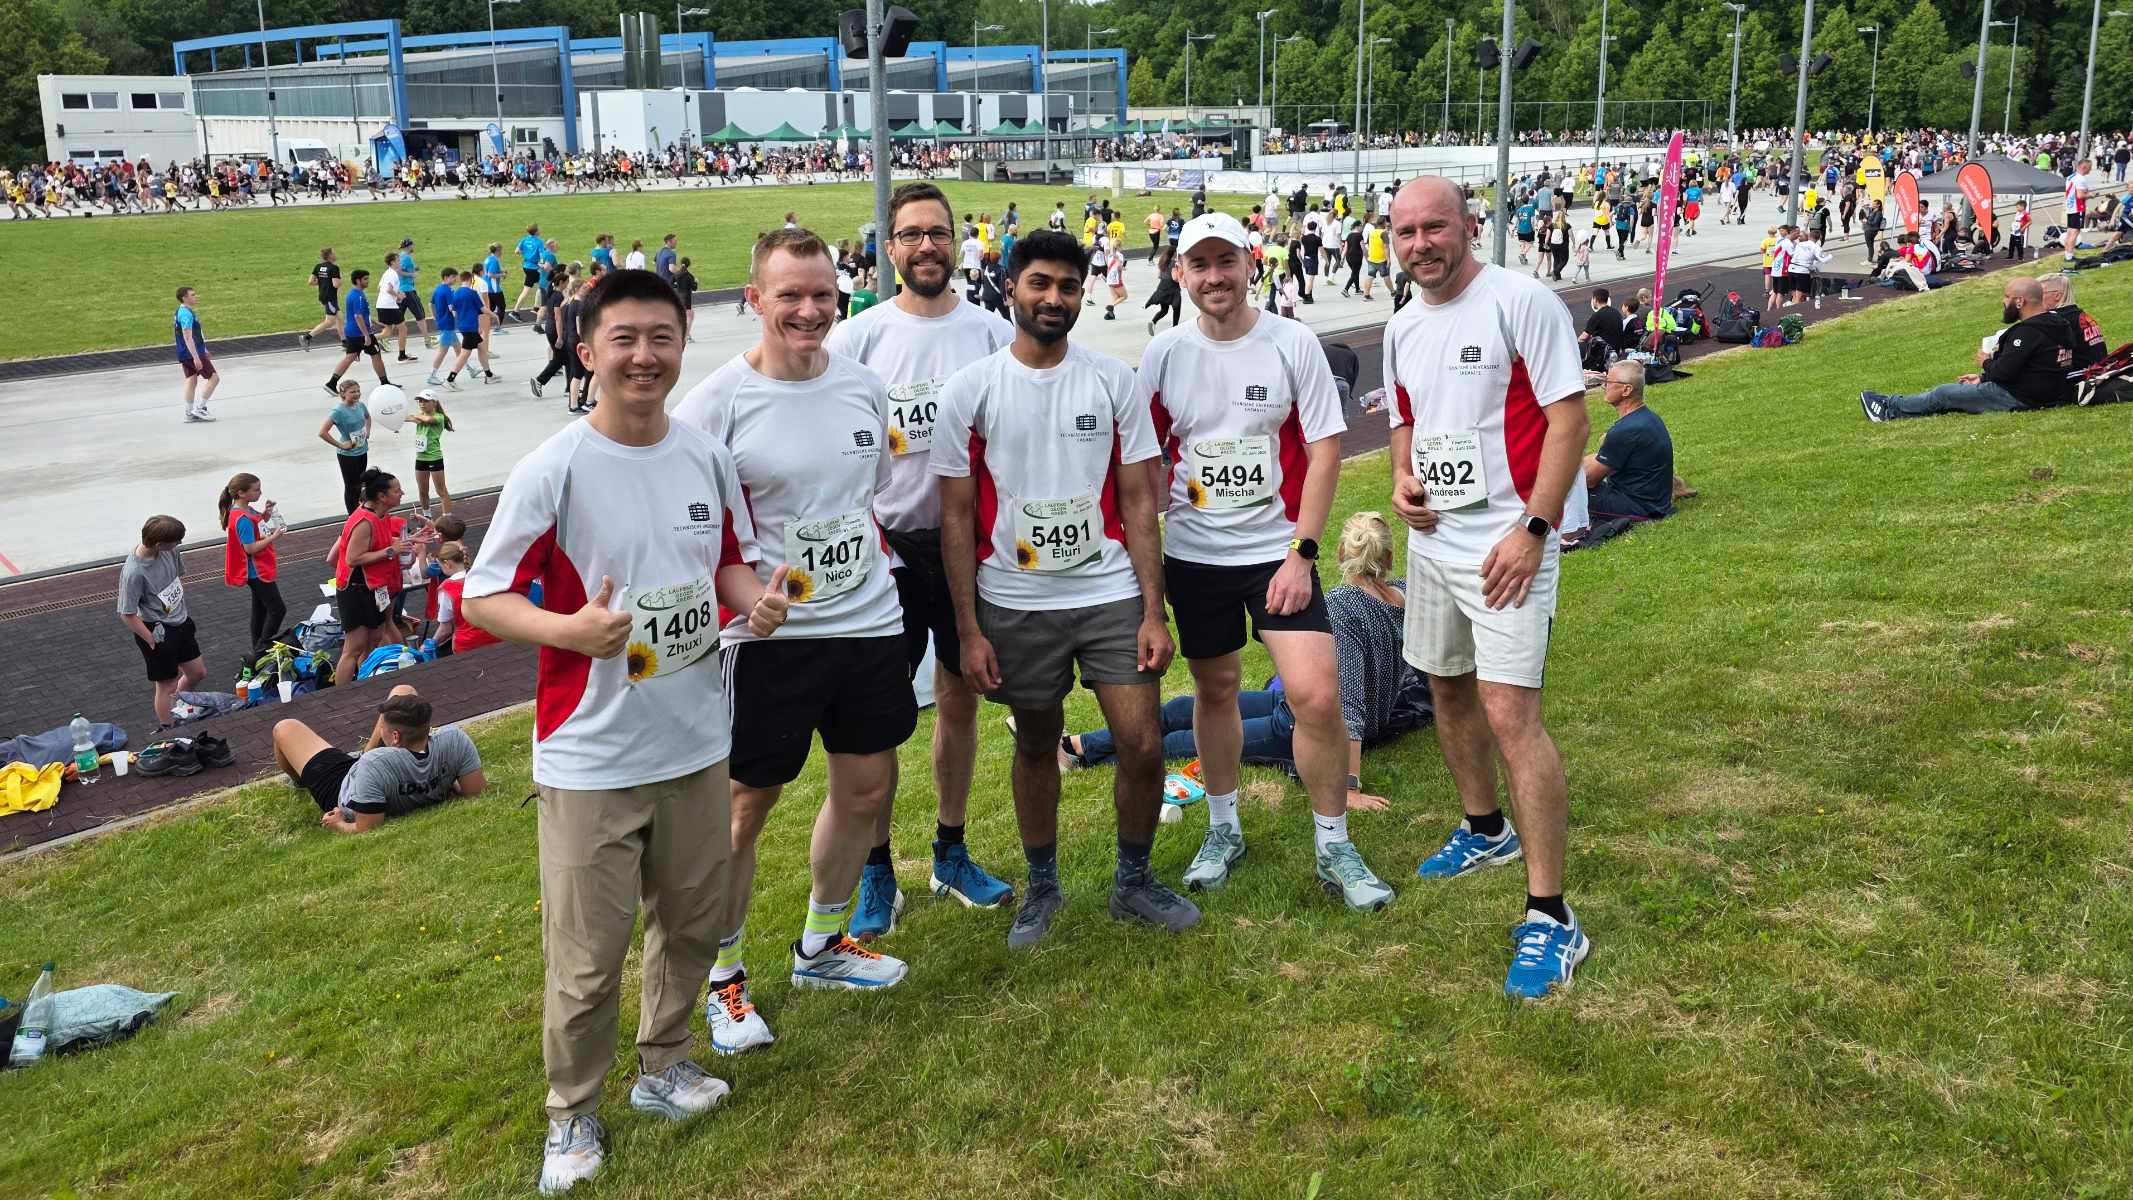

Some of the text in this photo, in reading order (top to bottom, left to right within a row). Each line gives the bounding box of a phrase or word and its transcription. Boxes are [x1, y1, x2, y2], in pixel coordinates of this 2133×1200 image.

[893, 401, 938, 429] 140
[1201, 463, 1265, 488] 5494
[1215, 488, 1255, 498] Mischa
[1429, 487, 1466, 497] Andreas
[1031, 519, 1091, 549] 5491
[801, 535, 864, 572] 1407
[1051, 544, 1081, 559] Eluri
[825, 567, 853, 584] Nico
[643, 600, 712, 644] 1408
[666, 633, 702, 658] Zhuxi
